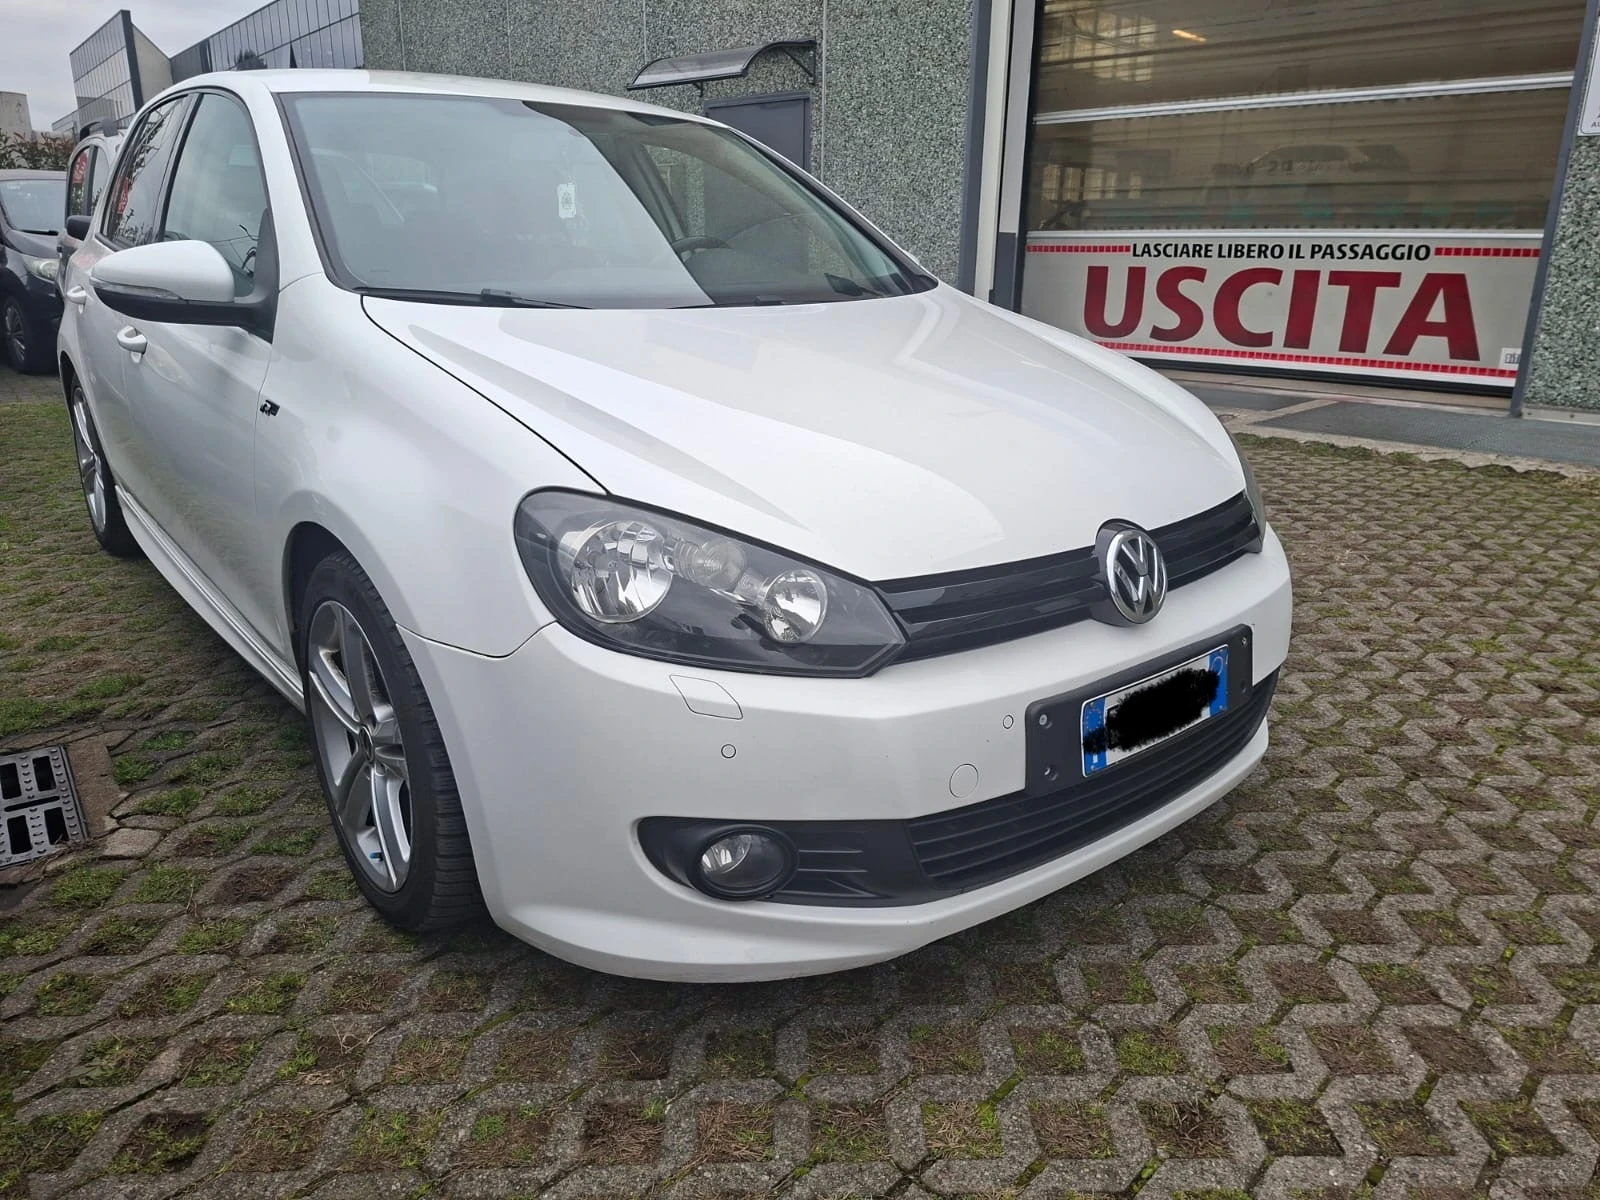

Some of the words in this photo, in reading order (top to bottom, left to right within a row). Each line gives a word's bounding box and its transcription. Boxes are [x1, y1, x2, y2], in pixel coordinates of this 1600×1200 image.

[1132, 243, 1214, 258] LASCIARE
[1217, 243, 1284, 260] LIBERO
[1288, 244, 1306, 260] IL
[1310, 244, 1431, 261] PASSAGGIO
[1083, 265, 1481, 362] USCITA
